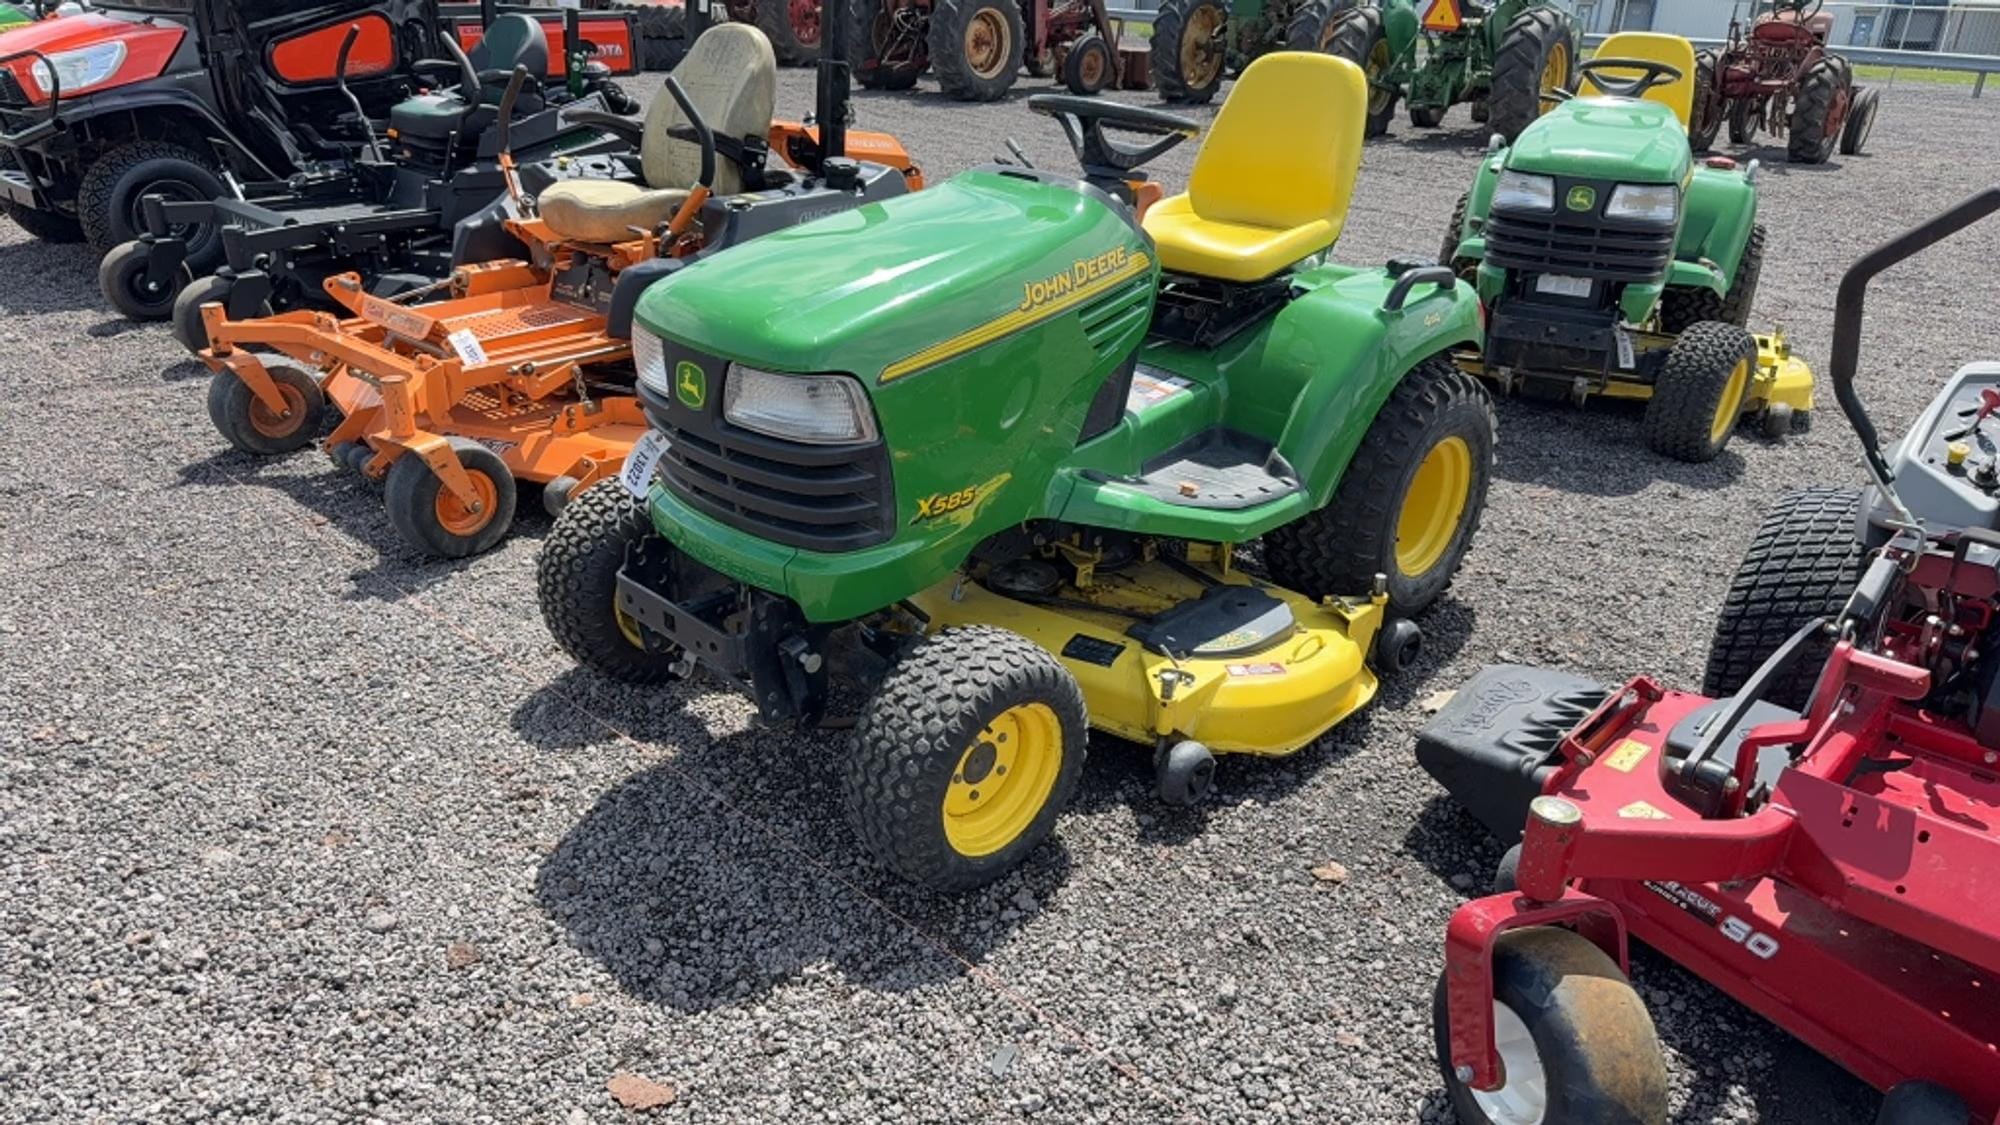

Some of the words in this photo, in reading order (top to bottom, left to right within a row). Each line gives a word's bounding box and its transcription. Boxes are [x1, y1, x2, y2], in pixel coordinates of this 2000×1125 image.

[1020, 268, 1073, 311] JOHN
[1073, 245, 1128, 288] DEERE
[908, 484, 978, 526] X585
